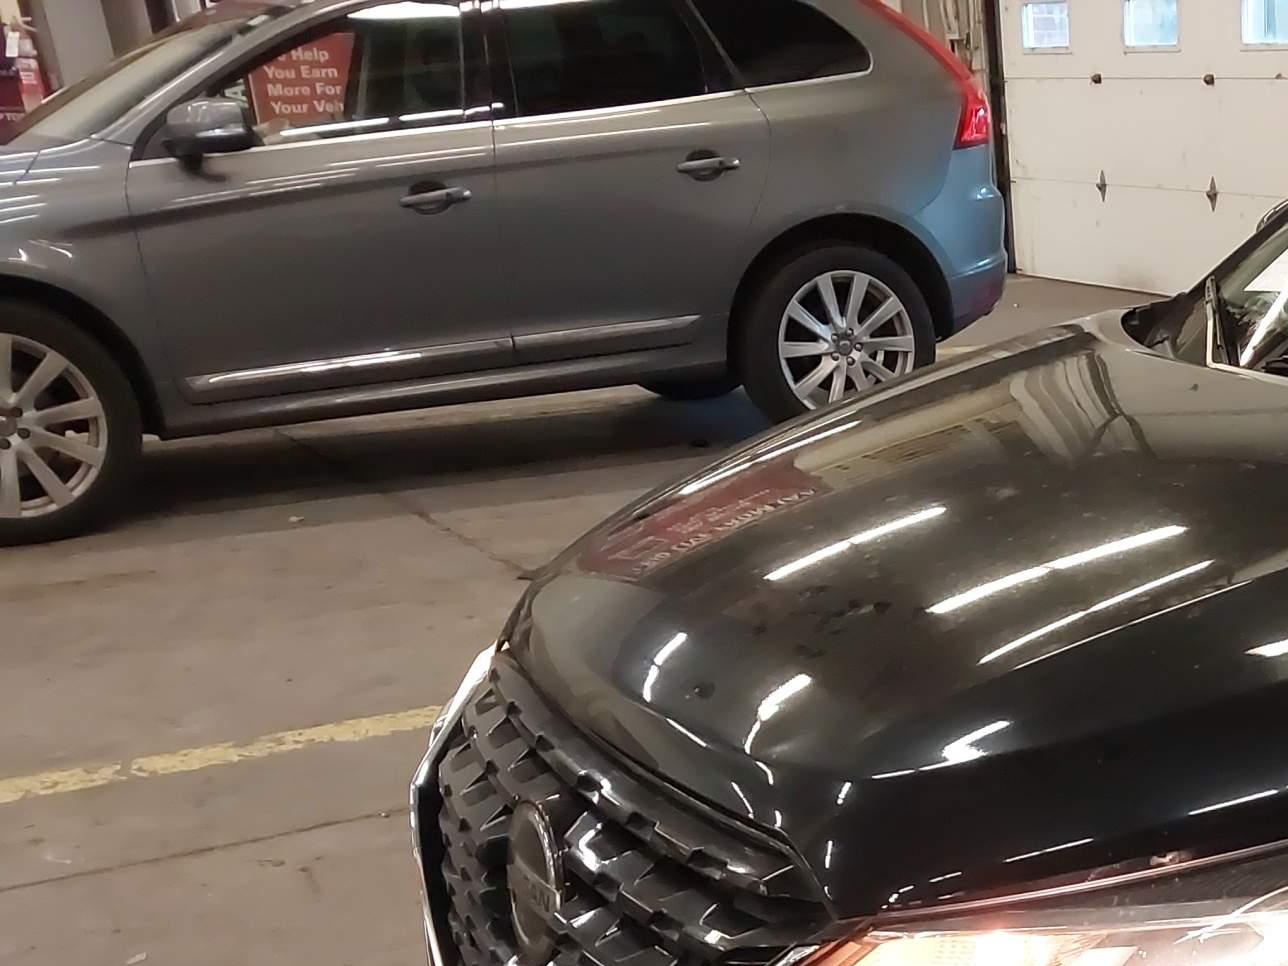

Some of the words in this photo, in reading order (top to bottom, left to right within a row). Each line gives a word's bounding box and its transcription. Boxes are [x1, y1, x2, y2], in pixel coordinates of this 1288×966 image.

[290, 46, 329, 63] Help
[263, 65, 296, 79] You
[300, 65, 338, 78] Earn
[266, 83, 310, 97] More
[315, 82, 342, 95] For
[270, 100, 308, 114] Your
